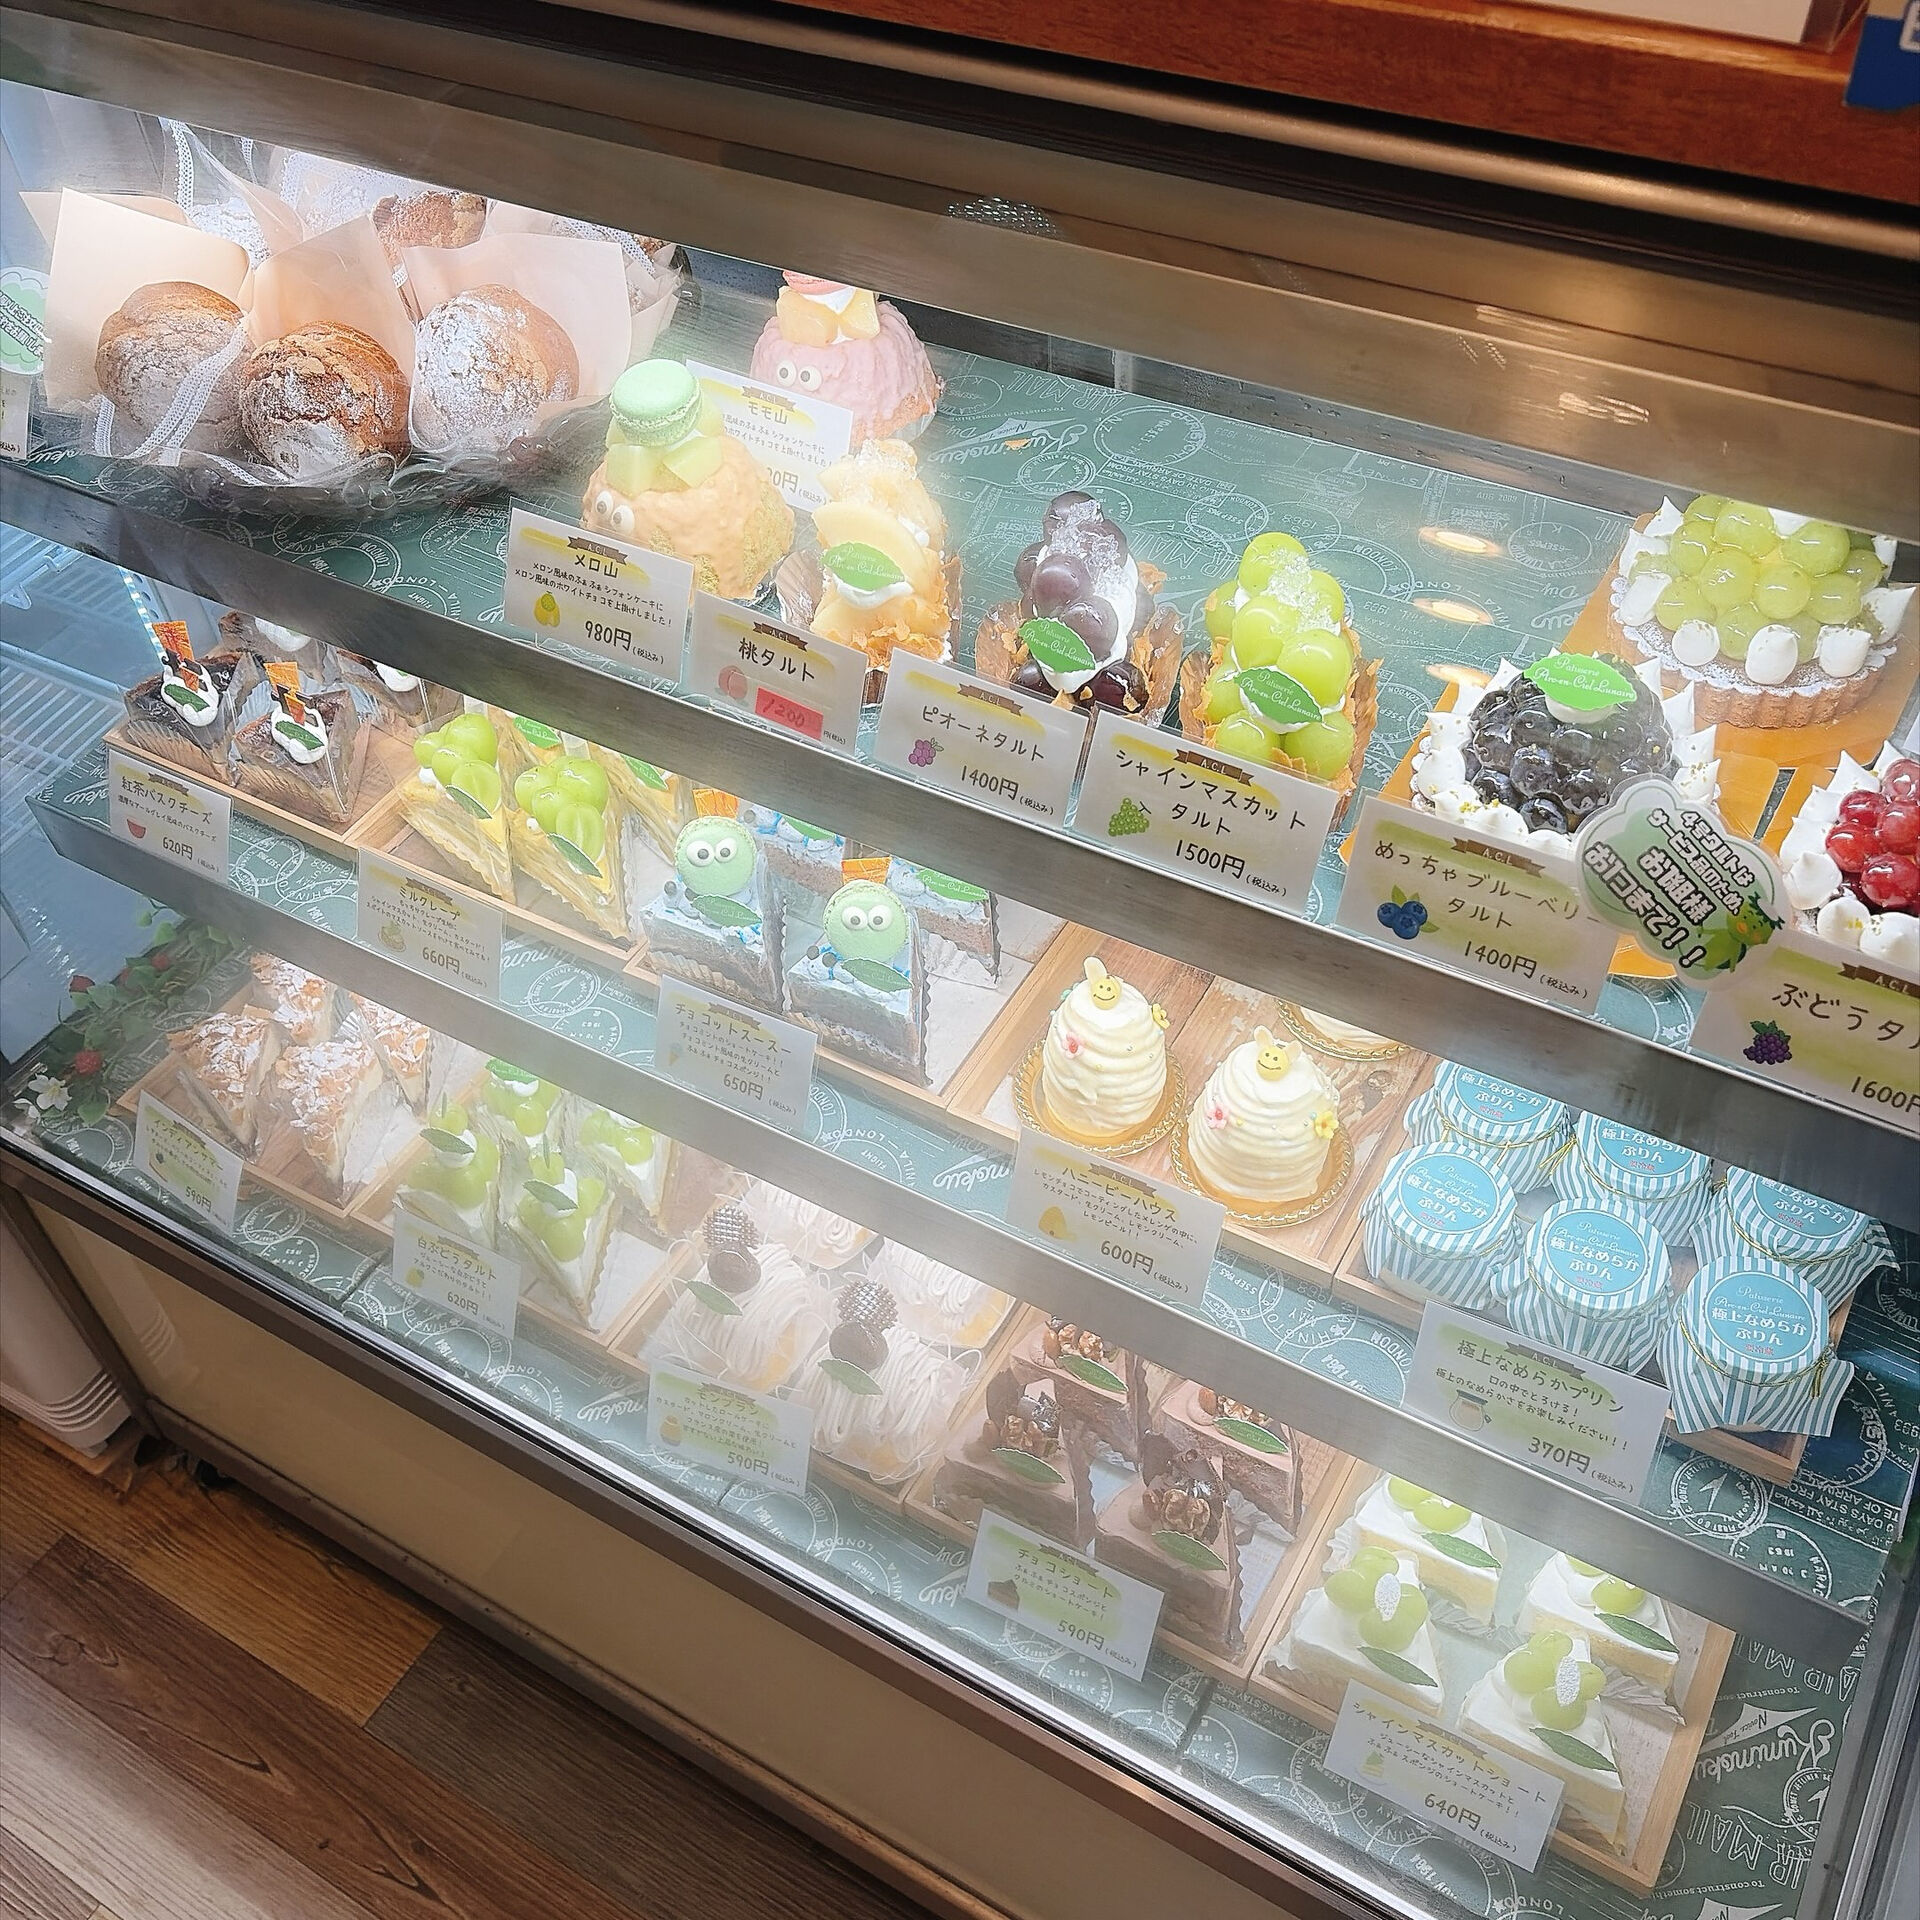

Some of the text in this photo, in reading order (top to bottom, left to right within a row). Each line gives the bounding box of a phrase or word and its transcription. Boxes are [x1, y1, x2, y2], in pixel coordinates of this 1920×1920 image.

[748, 401, 788, 424] モモ山
[723, 413, 825, 454] 風味のふぁふぁシフォンケーキに
[359, 540, 390, 568] LONDON
[574, 554, 618, 578] メロ山
[585, 620, 632, 651] 980円
[738, 637, 815, 682] 桃タルト
[762, 698, 805, 727] 1200
[922, 705, 1044, 762] ピオーネタルト
[121, 776, 213, 824] 紅茶バスクチーズ
[961, 765, 1054, 815] 1400円 (税込み)
[1116, 749, 1306, 830] シャインマスカット
[1171, 803, 1231, 836] タルト
[162, 836, 193, 860] 620円
[1647, 808, 1744, 916] サービス品のため、
[1681, 811, 1754, 887] 4号タルトは
[1176, 839, 1287, 897] 1500円 (税込み)
[1375, 840, 1601, 925] めっちゃブルーベリー
[400, 886, 460, 921] ミルクレープ
[1448, 898, 1512, 929] タルト
[422, 947, 460, 974] 660円
[1464, 940, 1588, 999] 1400円 (税込み)
[675, 1002, 792, 1055] チョコットスースー
[724, 1073, 764, 1100] 650円
[1460, 1072, 1542, 1107] 極上なめらか
[1474, 1091, 1516, 1112] ぷりん
[1601, 1128, 1687, 1155] 極上なめらか
[1621, 1146, 1665, 1164] ぷりん
[861, 1149, 887, 1170] FLIGHT
[185, 1186, 211, 1212] 590円
[1062, 1167, 1177, 1223] ハニービーハウス
[1405, 1174, 1488, 1220] 極上なめらか
[1417, 1197, 1458, 1223] ぷりん
[1760, 1177, 1848, 1224] 極上なめらか
[1773, 1199, 1817, 1225] ぷりん
[418, 1236, 496, 1280] 白ぶどうタルト
[1101, 1240, 1154, 1275] 600円
[1550, 1236, 1640, 1272] 極上なめらか
[1568, 1260, 1612, 1281] ぷりん
[447, 1291, 478, 1316] 620円
[1711, 1307, 1807, 1336] 極上なめらか
[1735, 1328, 1784, 1347] ぷりん
[1457, 1339, 1624, 1413] 極上なめらかプリン
[700, 1391, 759, 1415] モンブラン
[727, 1452, 769, 1476] 590円
[1528, 1437, 1635, 1494] 370円 (税込み)
[1816, 1494, 1849, 1517] STAY
[1850, 1508, 1883, 1530] DAYS
[1864, 1500, 1880, 1514] OF
[1018, 1549, 1113, 1599] チョコショート
[1057, 1620, 1104, 1650] 590円
[1737, 1686, 1800, 1700] To construct
[1352, 1702, 1546, 1804] シャインマスカットショート
[1424, 1793, 1481, 1832] 640円
[1685, 1801, 1763, 1870] MAIL
[1696, 1881, 1751, 1896] construct
[1751, 1880, 1765, 1889] To
